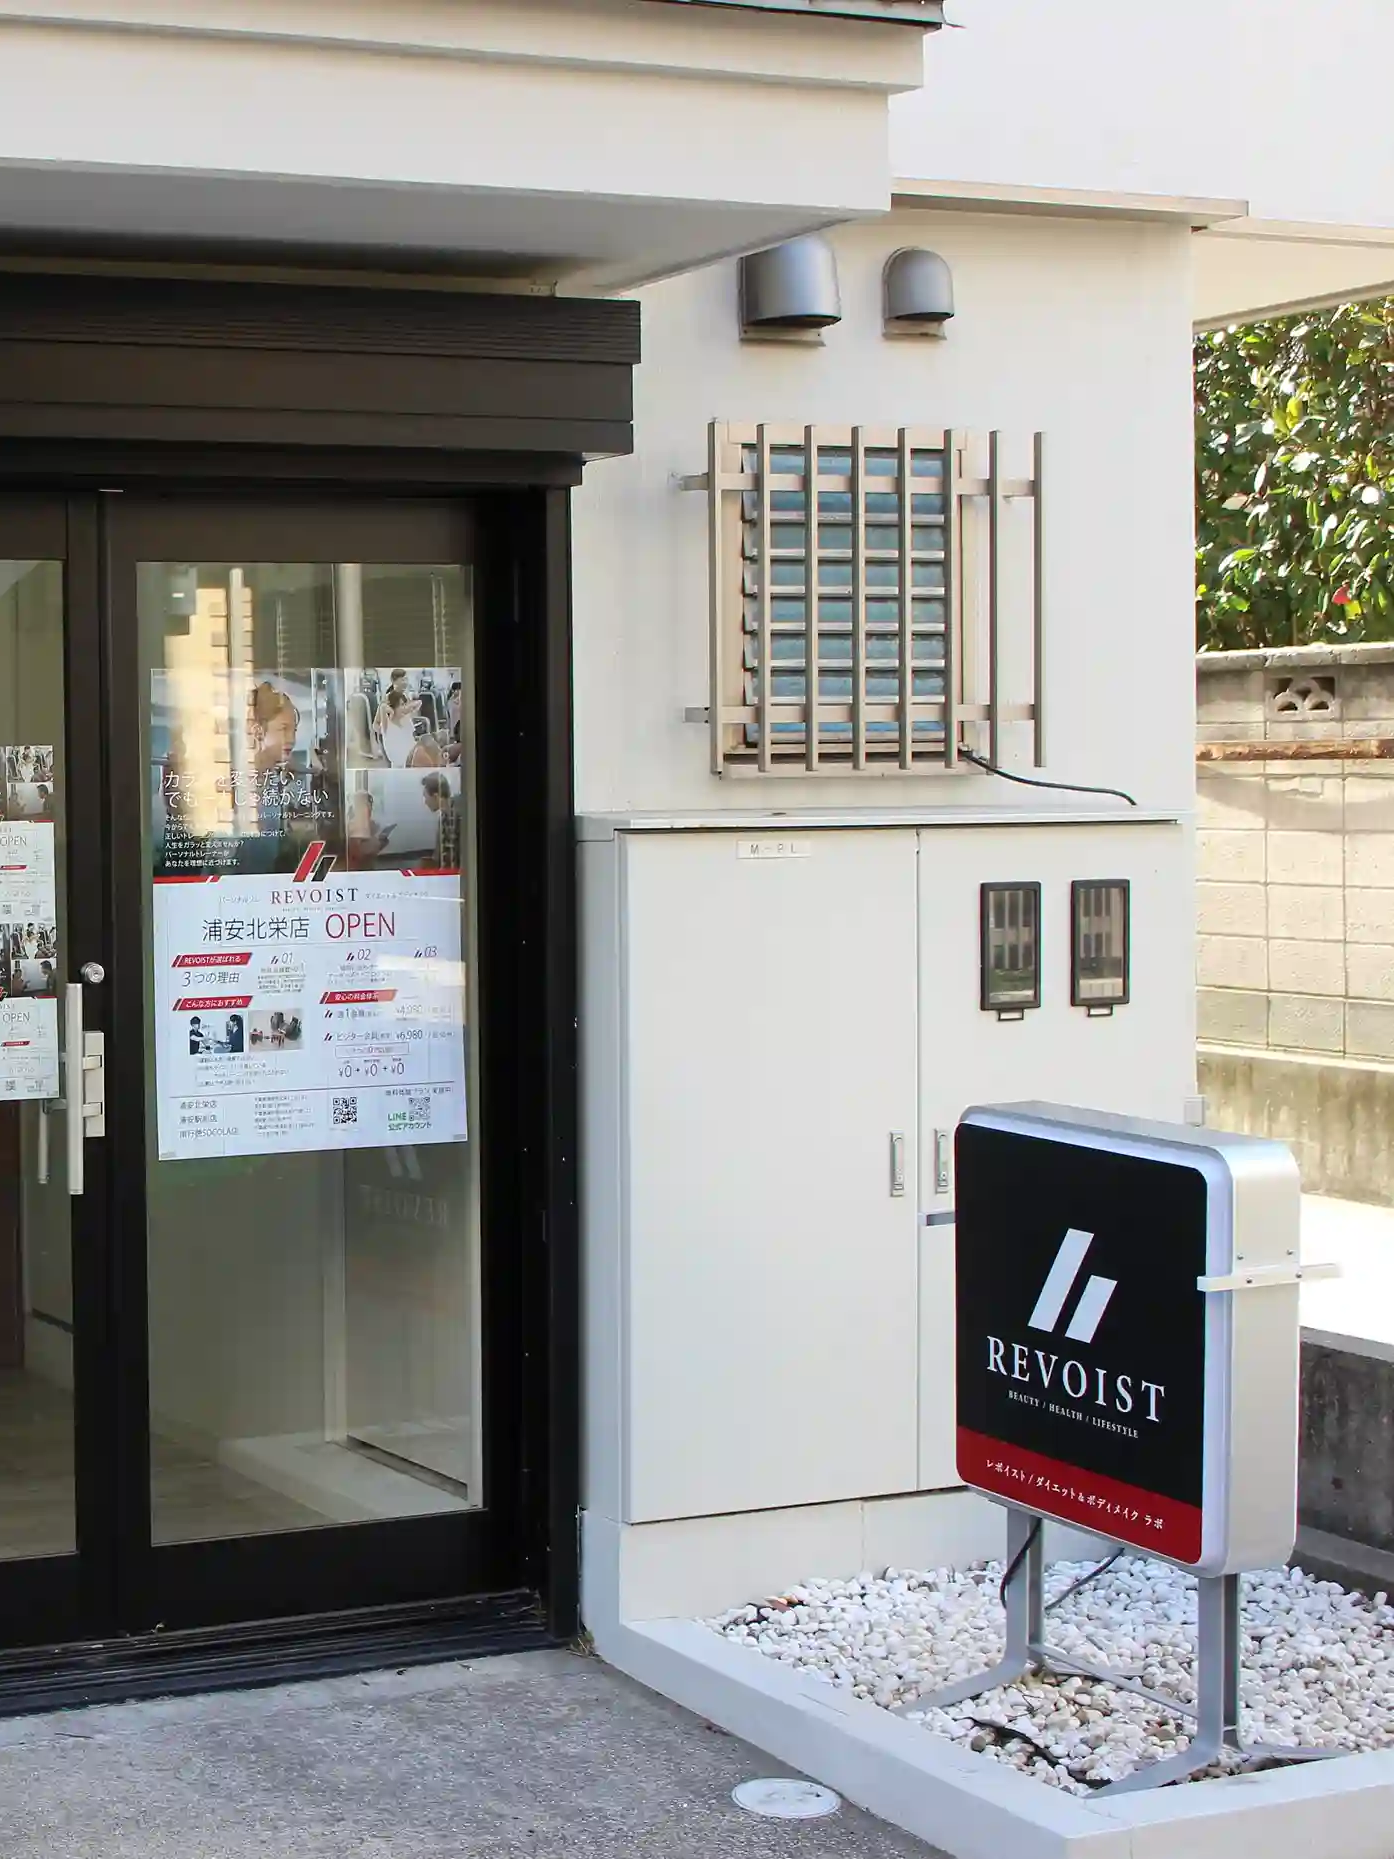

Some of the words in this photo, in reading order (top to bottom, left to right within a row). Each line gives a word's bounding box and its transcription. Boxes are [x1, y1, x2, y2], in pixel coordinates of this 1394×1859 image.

[0, 836, 27, 847] OPEN
[271, 888, 359, 905] REVOIST
[202, 917, 310, 942] 浦安北栄店
[325, 912, 396, 939] OPEN
[281, 952, 294, 964] 01
[357, 949, 372, 960] 02
[424, 946, 438, 958] 03
[182, 971, 240, 988] 3つの理由
[2, 1011, 30, 1023] OPEN
[387, 1112, 407, 1121] LINE
[986, 1335, 1166, 1423] REVOIST
[1008, 1390, 1040, 1407] BEAUTY
[1049, 1403, 1083, 1421] HEALTH
[1092, 1416, 1139, 1439] LIFESTYLE
